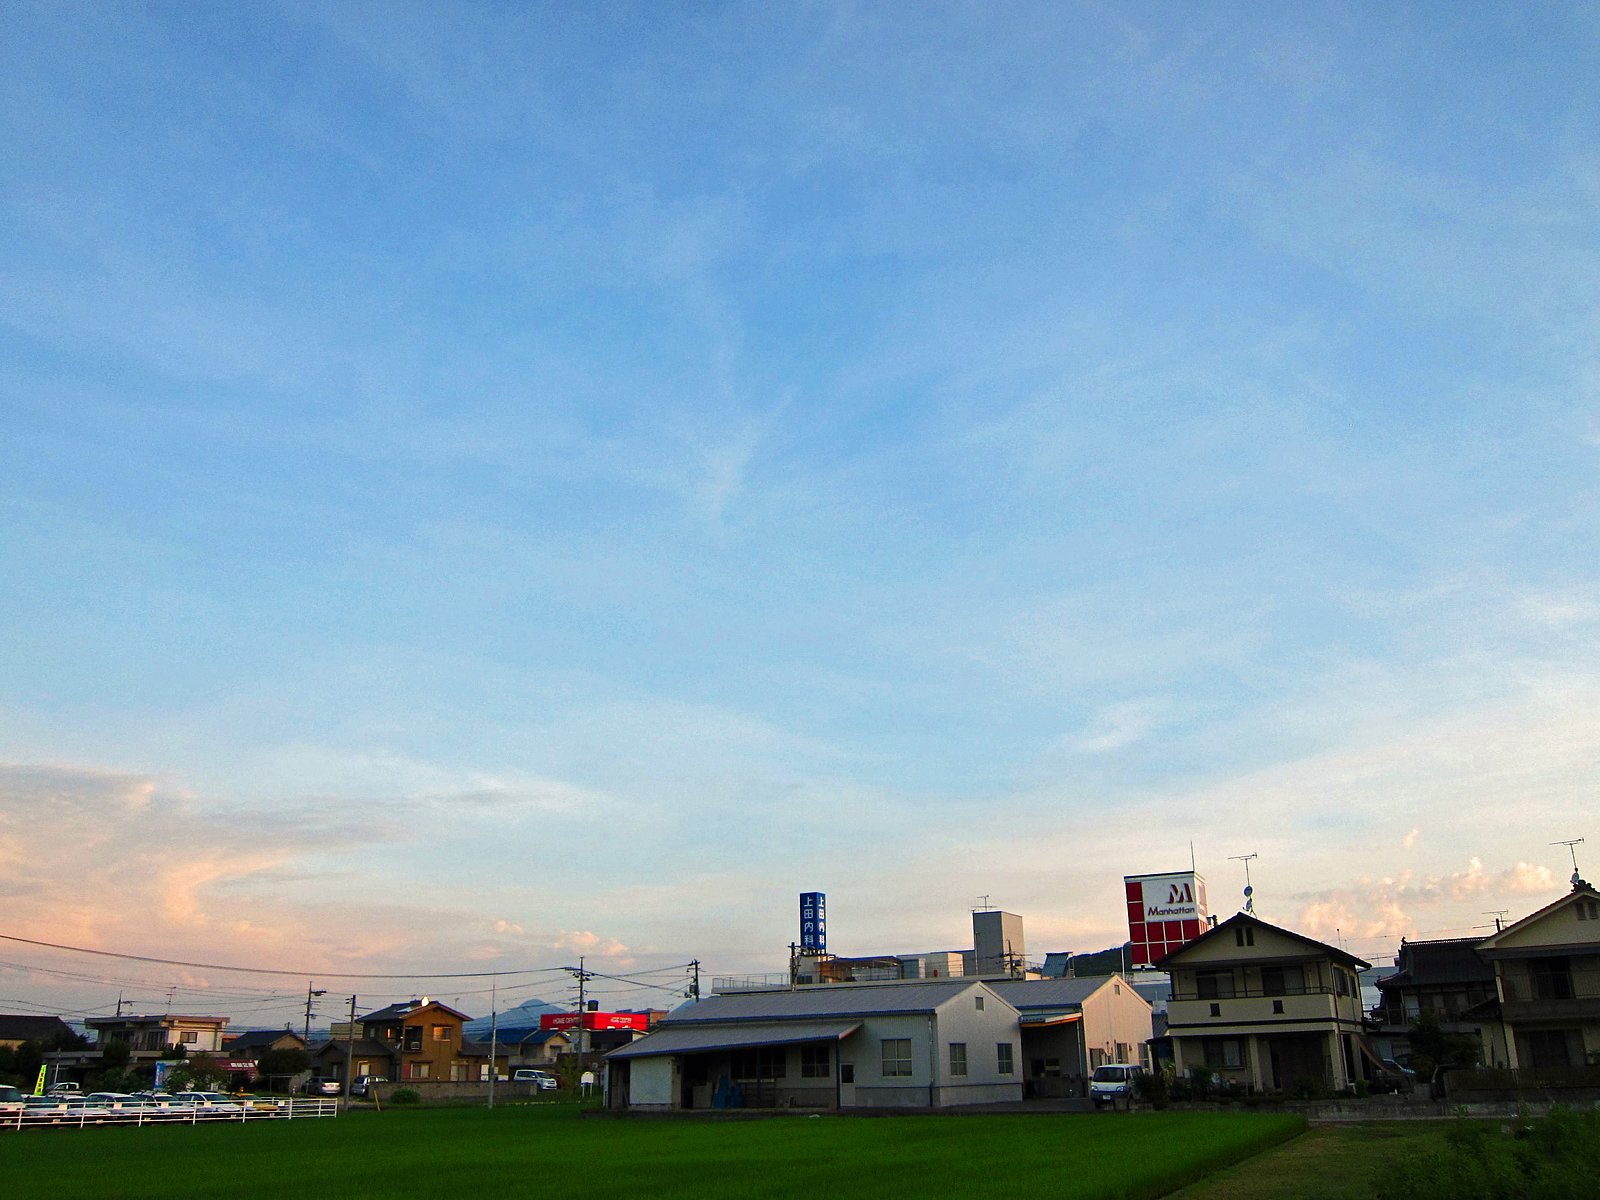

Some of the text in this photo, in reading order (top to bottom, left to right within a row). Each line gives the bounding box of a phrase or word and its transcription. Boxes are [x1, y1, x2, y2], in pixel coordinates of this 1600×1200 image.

[803, 896, 814, 946] 上田内科
[1148, 906, 1195, 916] Manhattan
